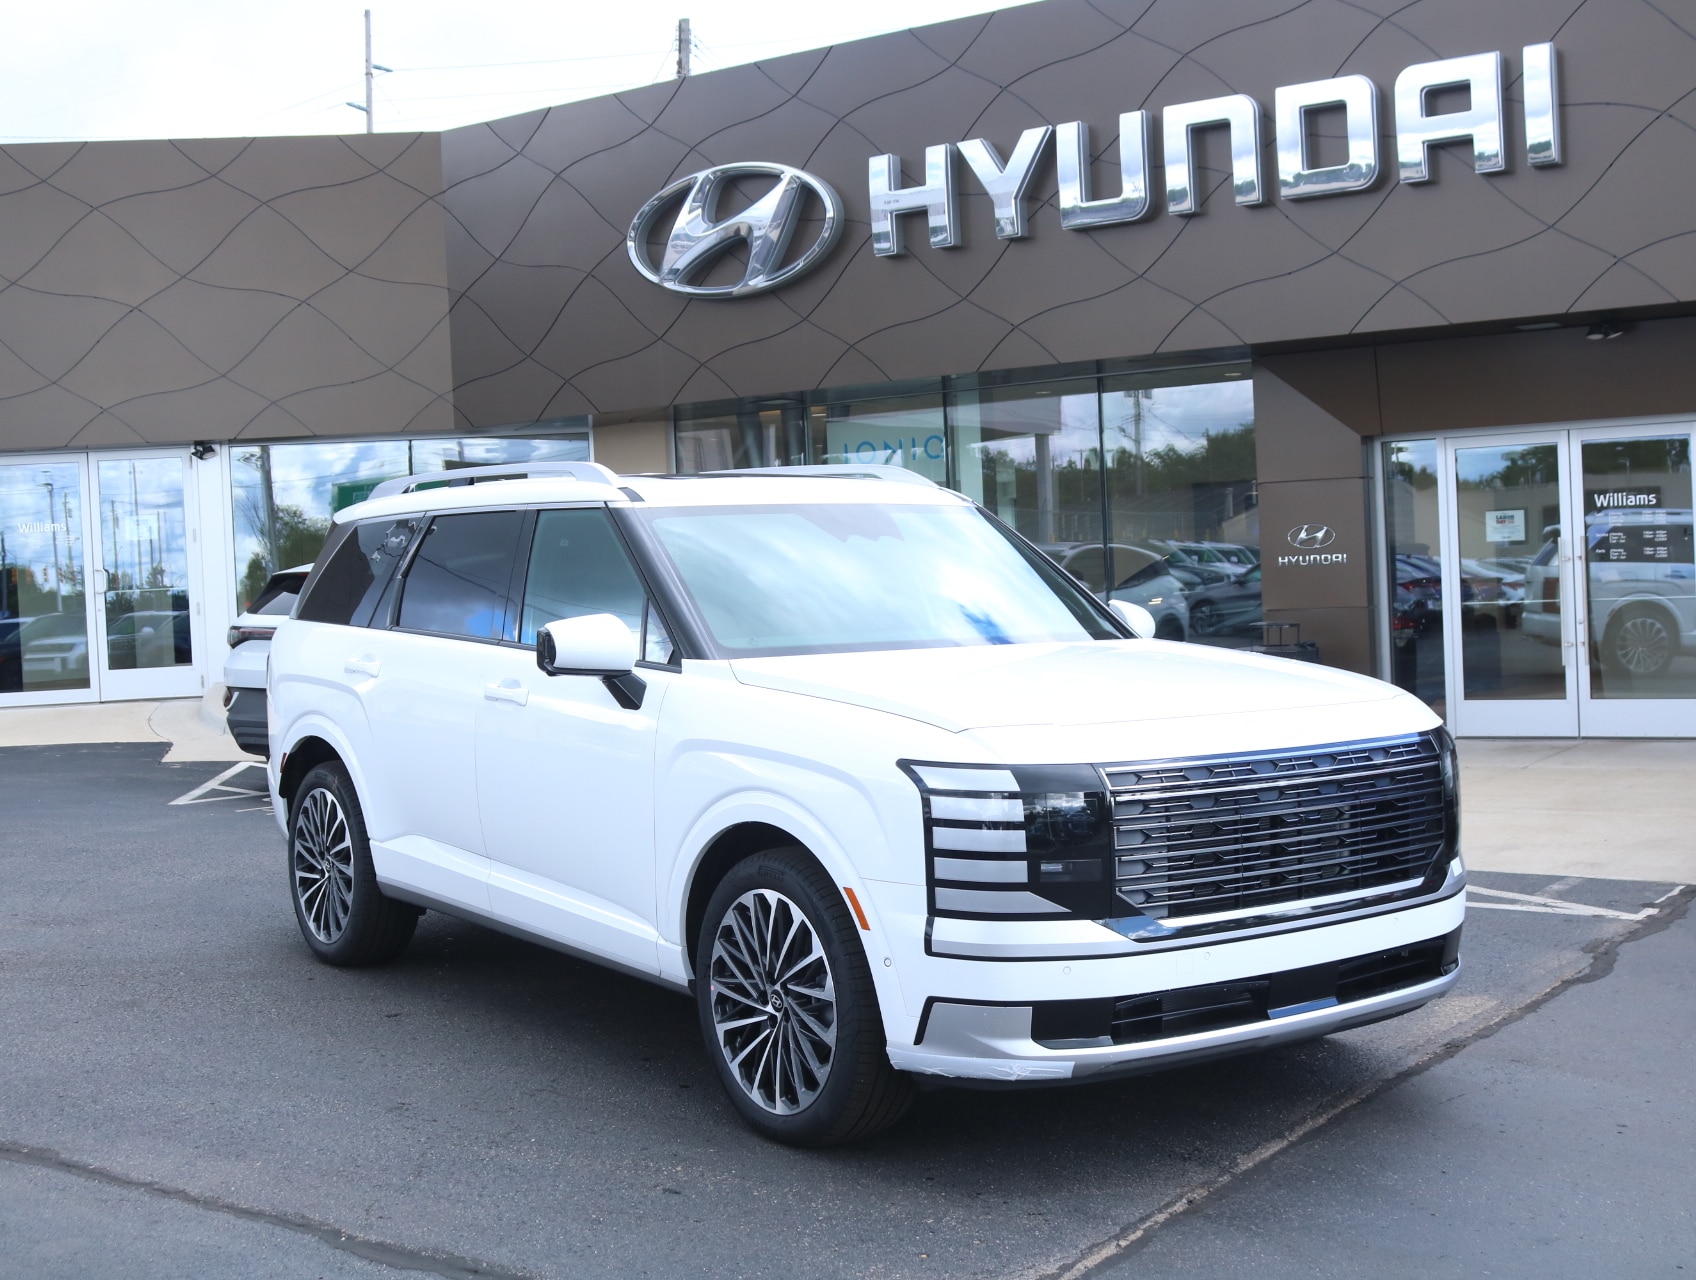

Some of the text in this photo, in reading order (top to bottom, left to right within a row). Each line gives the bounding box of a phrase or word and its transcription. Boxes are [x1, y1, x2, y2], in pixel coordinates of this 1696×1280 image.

[868, 41, 1563, 257] HYUNDAI
[1594, 492, 1657, 507] Williams
[17, 521, 67, 534] Williams
[1278, 553, 1347, 566] HYUNDAI
